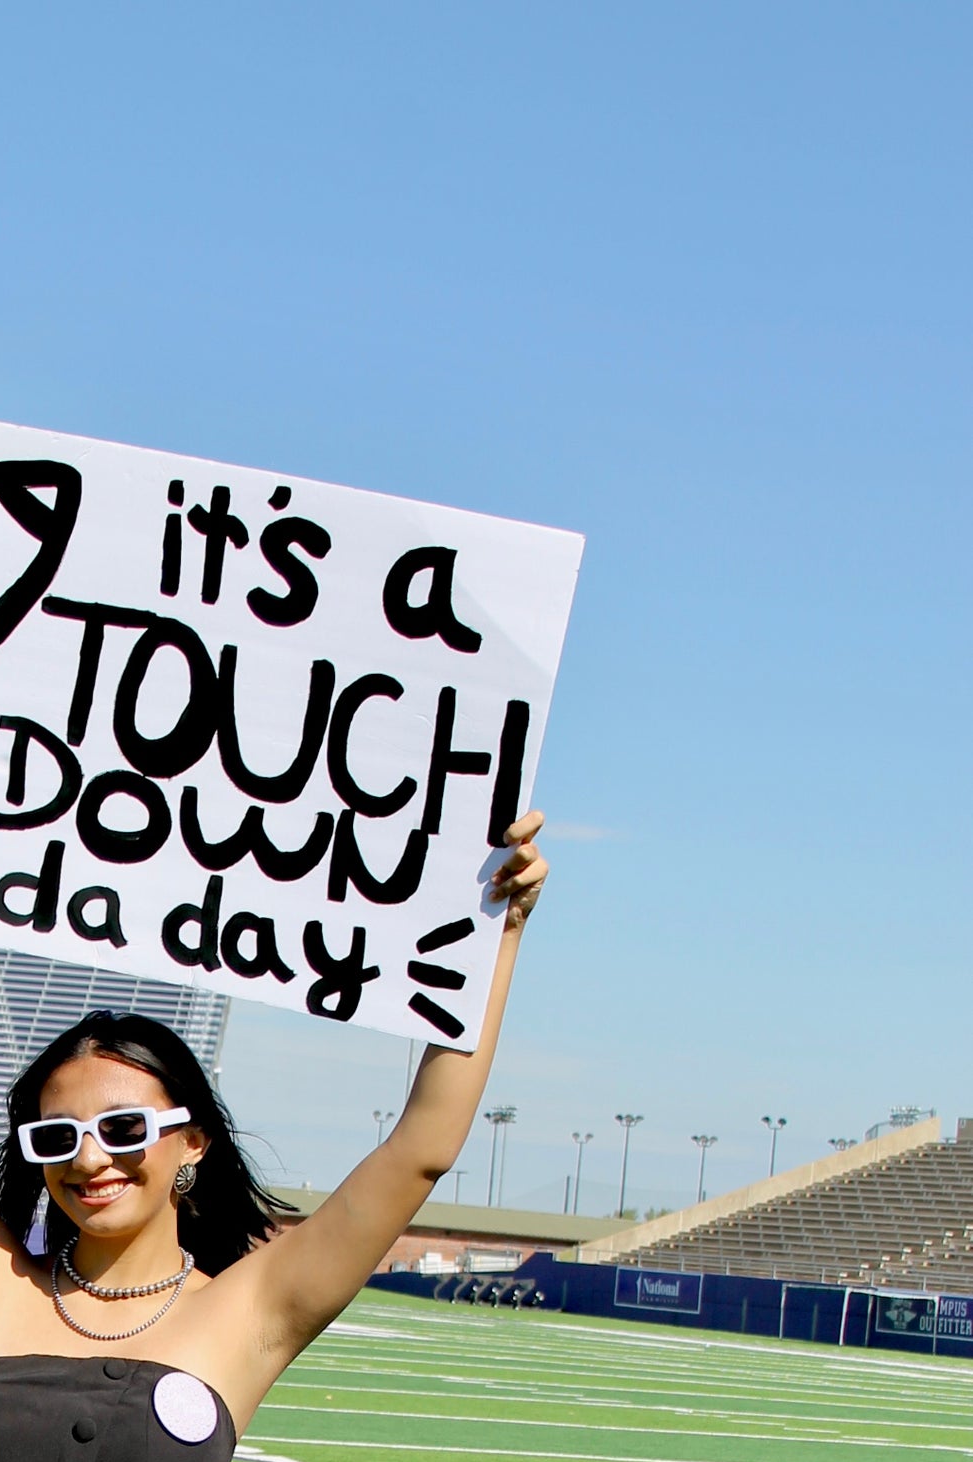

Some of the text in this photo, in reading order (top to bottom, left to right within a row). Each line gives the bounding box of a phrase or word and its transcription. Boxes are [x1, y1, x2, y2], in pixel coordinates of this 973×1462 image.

[161, 480, 483, 653] it's a
[42, 596, 530, 849] TOUCH
[162, 875, 381, 1022] day
[643, 1278, 680, 1297] National
[919, 1315, 973, 1335] OUFITTER
[927, 1300, 968, 1317] CMPUS
